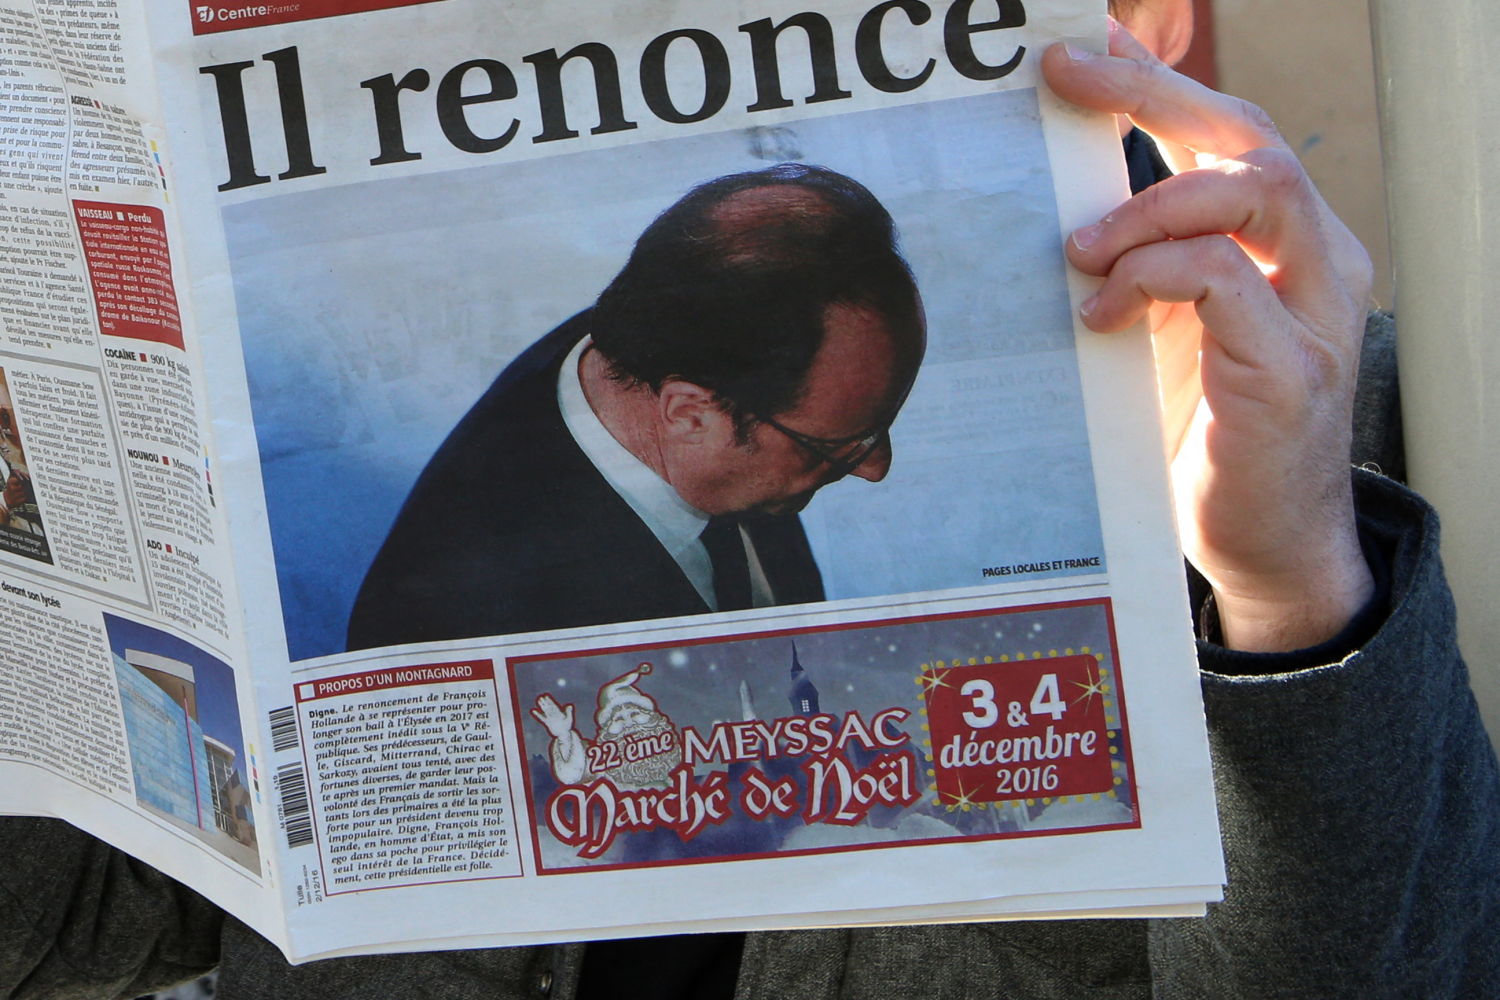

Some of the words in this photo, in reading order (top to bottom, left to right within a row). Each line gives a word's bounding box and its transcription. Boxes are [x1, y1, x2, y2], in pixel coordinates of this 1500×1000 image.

[198, 45, 327, 193] Il
[78, 208, 113, 220] VAISSEAU
[127, 212, 152, 223] Perdu
[104, 348, 136, 361] COCAÏNE
[127, 448, 159, 464] NOUNOU
[147, 539, 162, 551] ADO
[982, 566, 1012, 578] PAGES
[1012, 561, 1051, 575] LOCALES
[1052, 560, 1063, 570] ET
[1064, 556, 1100, 569] FRANCE
[0, 580, 26, 597] devant
[24, 591, 42, 602] son
[39, 593, 61, 609] lycée
[319, 677, 363, 694] PROPOS
[365, 673, 393, 687] D'UN
[396, 665, 473, 683] MONTAGNARD
[308, 708, 338, 719] Digne.
[342, 704, 354, 713] Le
[358, 695, 423, 711] renoncement
[426, 693, 439, 702] de
[443, 689, 486, 701] François
[961, 679, 999, 729] 3
[1006, 701, 1030, 728] &
[1029, 673, 1067, 721] 4
[588, 743, 620, 772] 22
[625, 733, 673, 761] ème
[683, 710, 908, 764] MEYSSAC
[941, 725, 1097, 770] décembre
[996, 764, 1059, 794] 2016
[551, 768, 725, 853] Marché
[745, 772, 793, 816] de
[810, 757, 912, 820] Noël
[312, 869, 323, 903] 2/12/16
